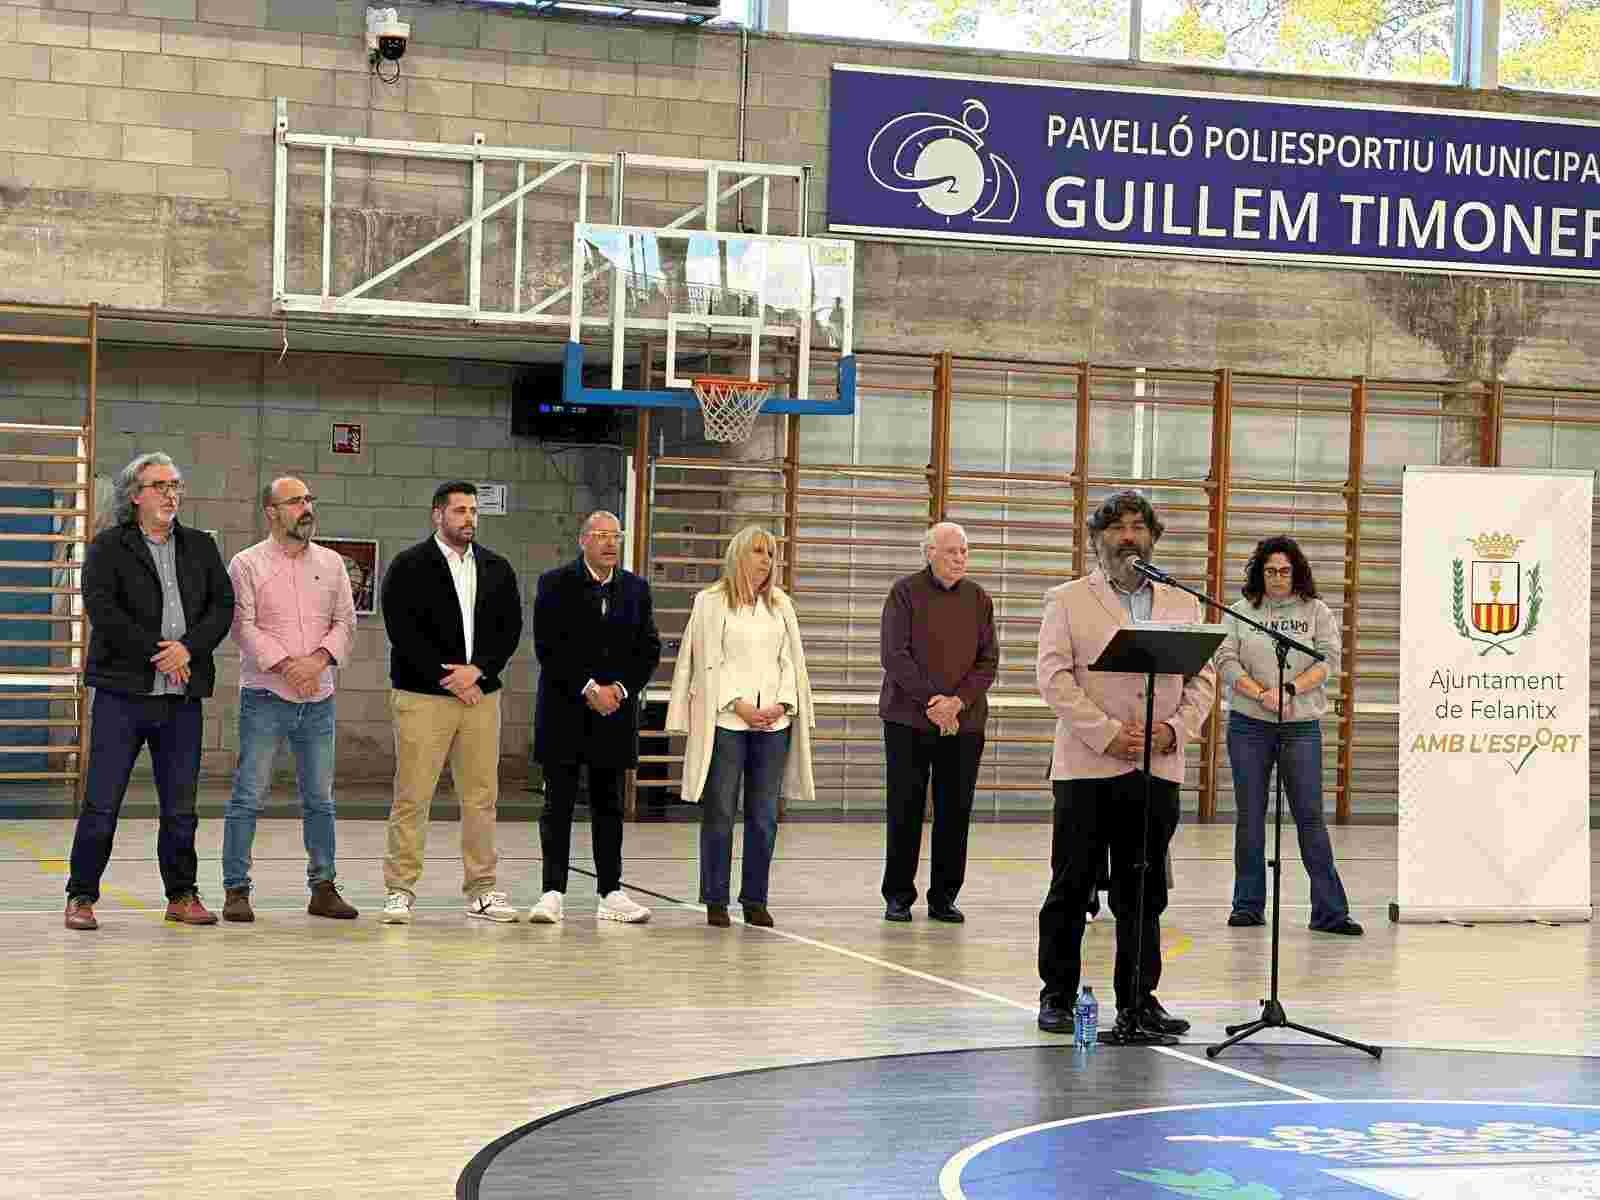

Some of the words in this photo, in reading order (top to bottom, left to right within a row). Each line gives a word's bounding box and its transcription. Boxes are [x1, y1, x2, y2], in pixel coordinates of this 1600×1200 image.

[1047, 114, 1193, 157] PAVELLÓ
[1205, 125, 1434, 173] POLIESPORTIU
[1445, 142, 1600, 185] MUNICIPA
[1045, 175, 1319, 243] GUILLEM
[1428, 669, 1565, 695] Ajuntament
[1435, 698, 1463, 720] de
[1471, 699, 1557, 720] Felanitx
[1410, 733, 1465, 753] AMB
[1470, 727, 1583, 754] L'ESPORT
